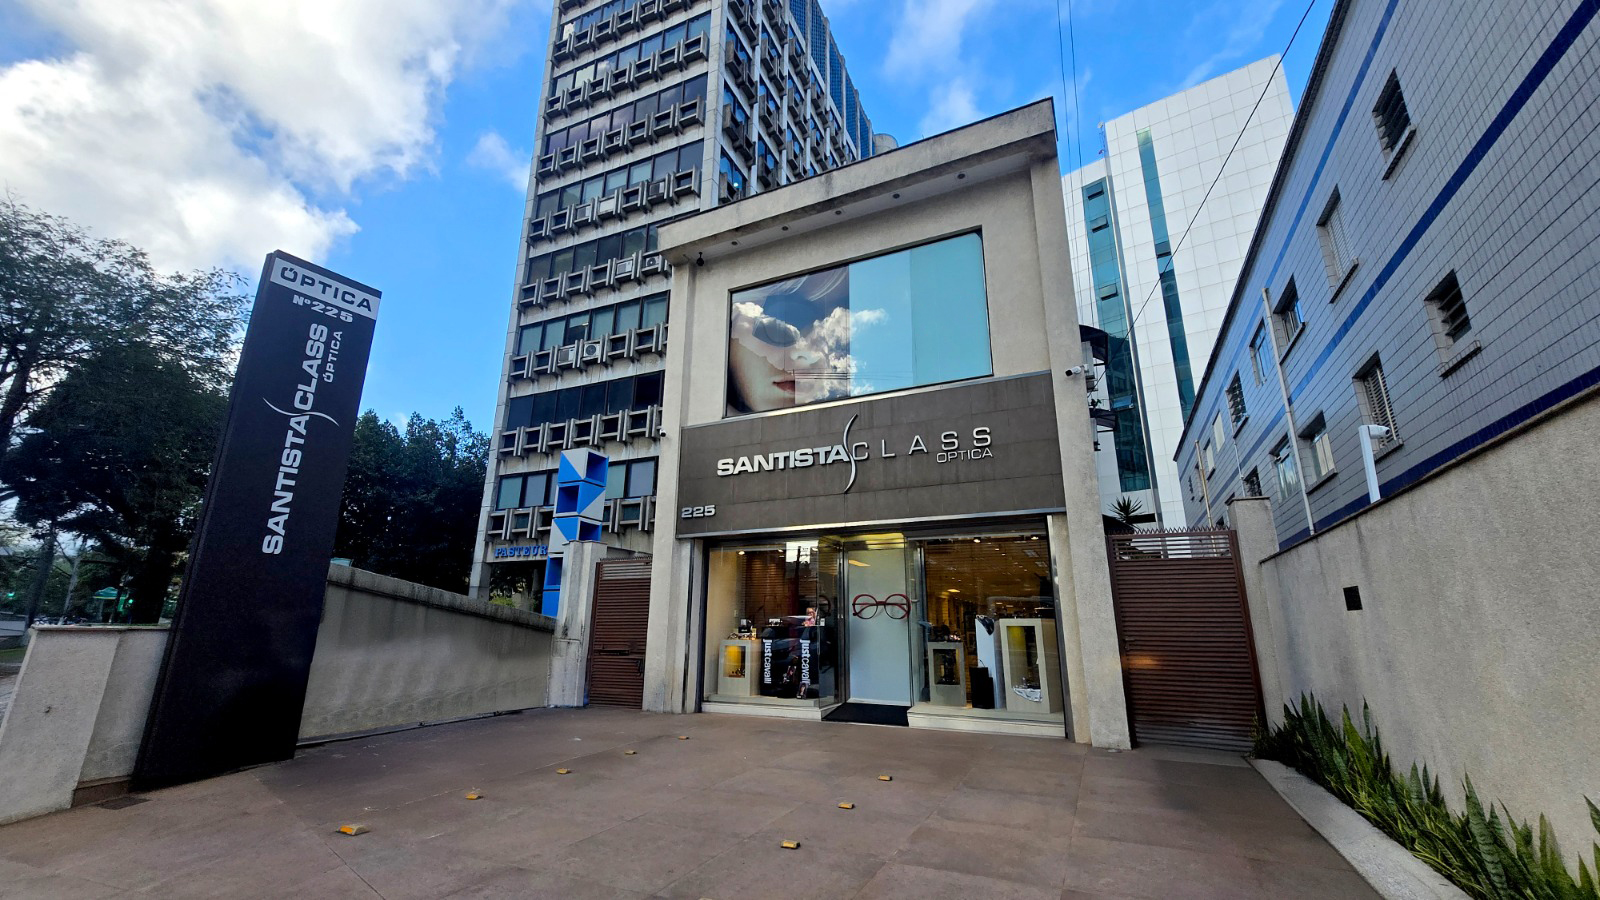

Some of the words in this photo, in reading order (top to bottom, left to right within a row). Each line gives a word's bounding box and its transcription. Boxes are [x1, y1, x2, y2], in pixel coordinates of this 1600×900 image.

[280, 266, 372, 312] ÓPTICA
[322, 331, 342, 383] ÓPTICA
[262, 415, 310, 555] SANTISTA
[293, 323, 328, 411] CLASS
[717, 444, 849, 476] SANTISTA
[851, 427, 992, 461] CLASS
[936, 447, 993, 463] OPTICA
[681, 504, 716, 518] 225
[494, 545, 548, 558] PASTEUR
